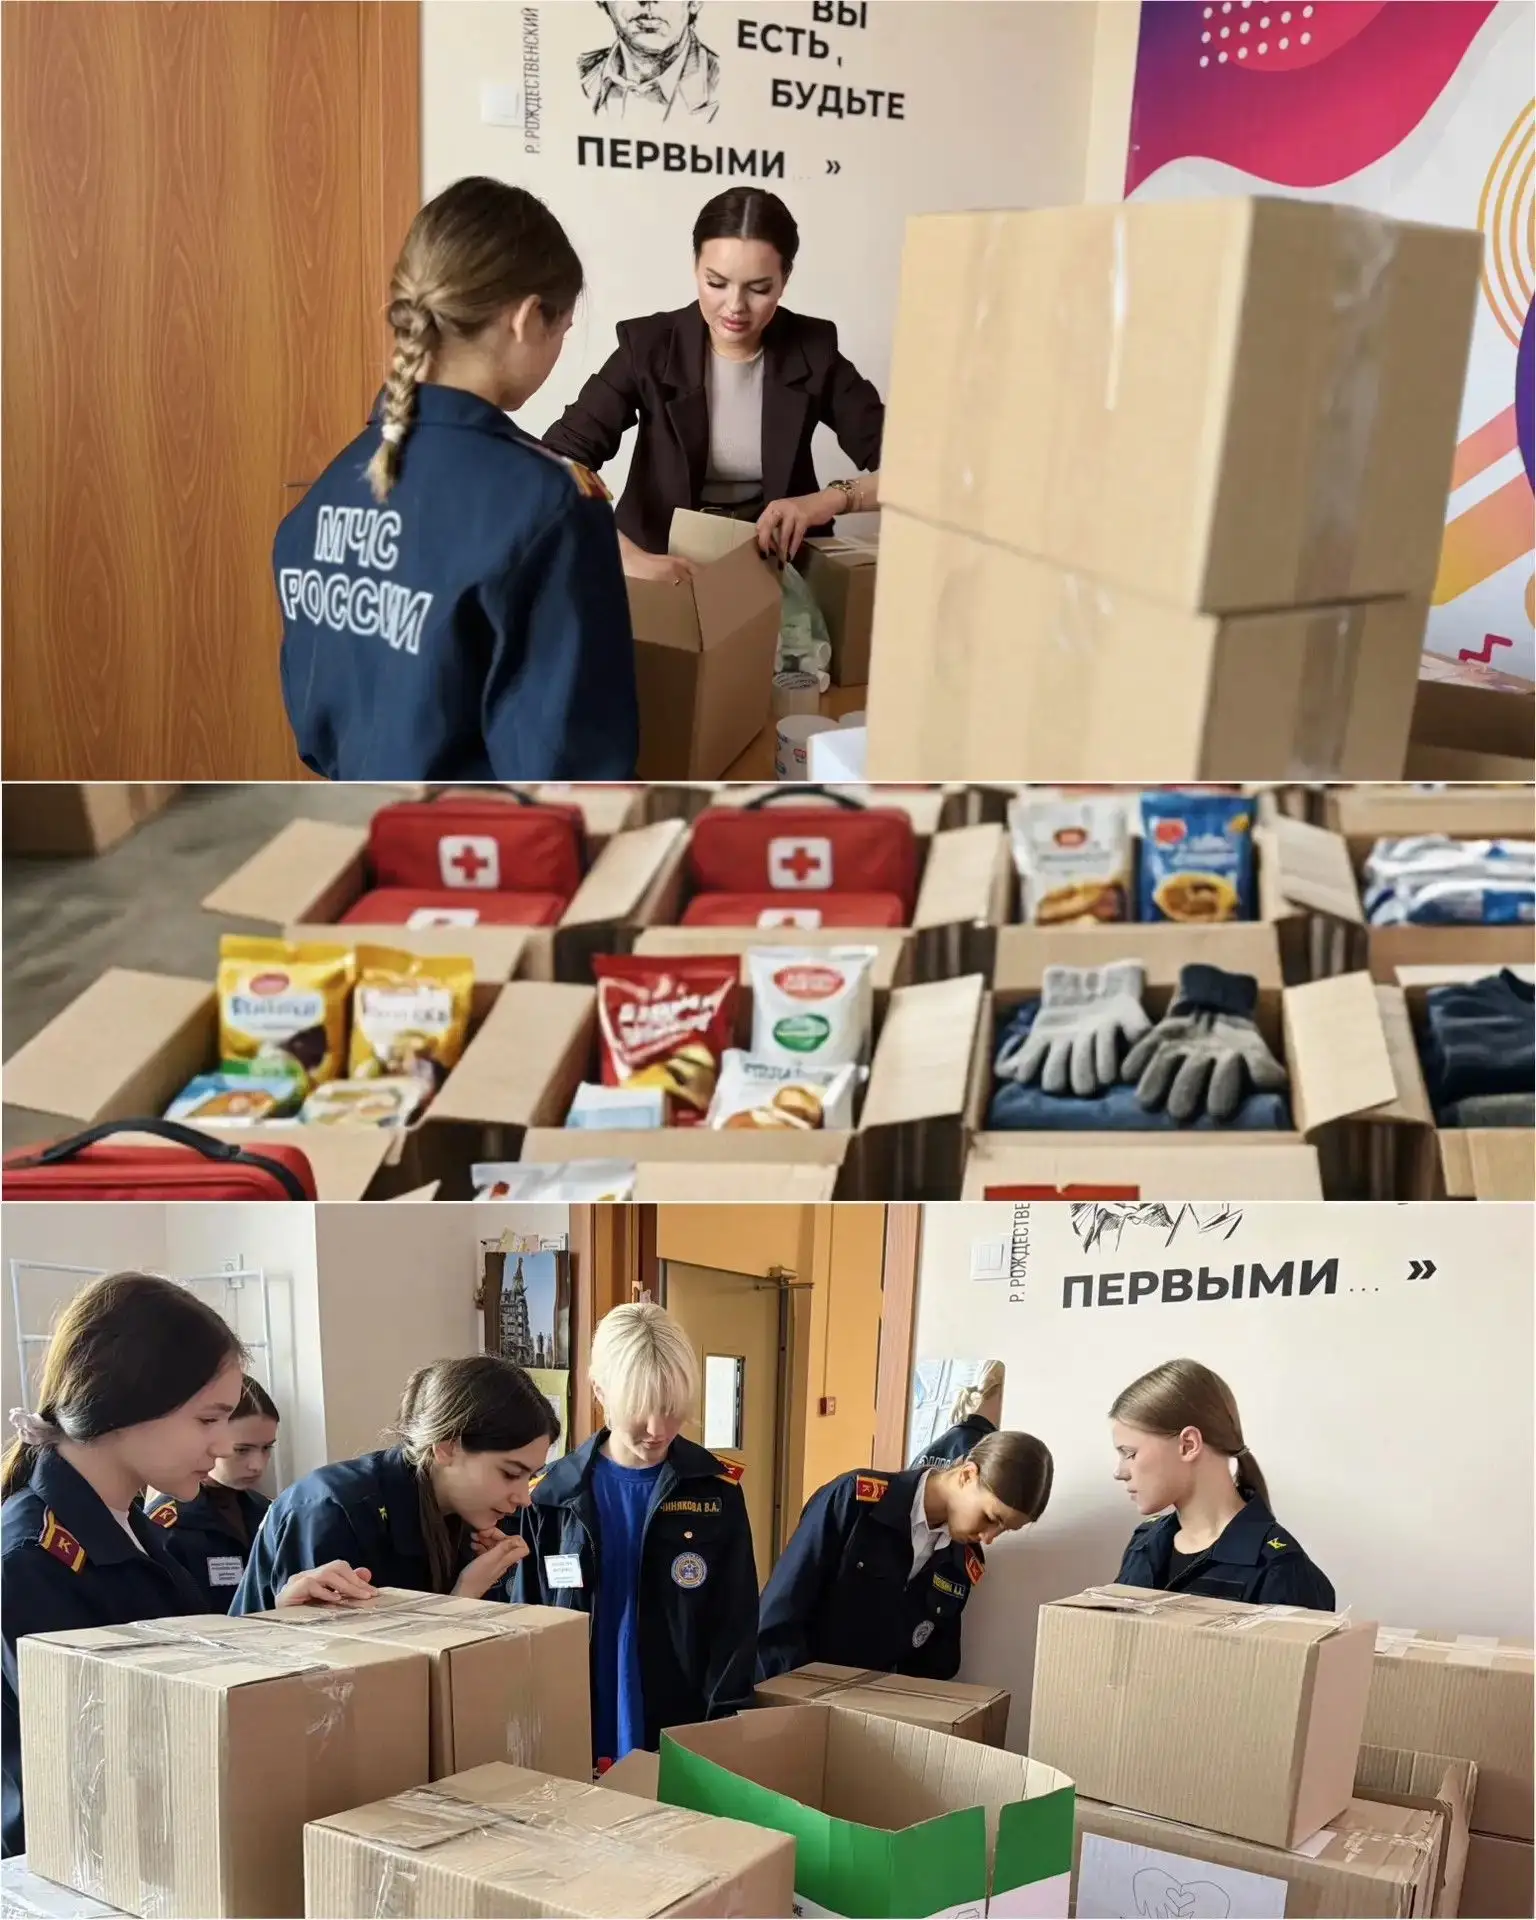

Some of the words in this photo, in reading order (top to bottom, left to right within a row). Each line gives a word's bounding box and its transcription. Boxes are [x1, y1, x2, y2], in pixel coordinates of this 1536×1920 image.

[812, 1, 867, 29] ВЫ
[521, 7, 542, 139] РОЖДЕСТВЕНСКИЙ
[771, 78, 905, 120] БУДЬТЕ
[313, 504, 402, 571] МЧС
[280, 568, 434, 655] РОССИИ
[1009, 1202, 1031, 1288] РОЖДЕСТВЕ
